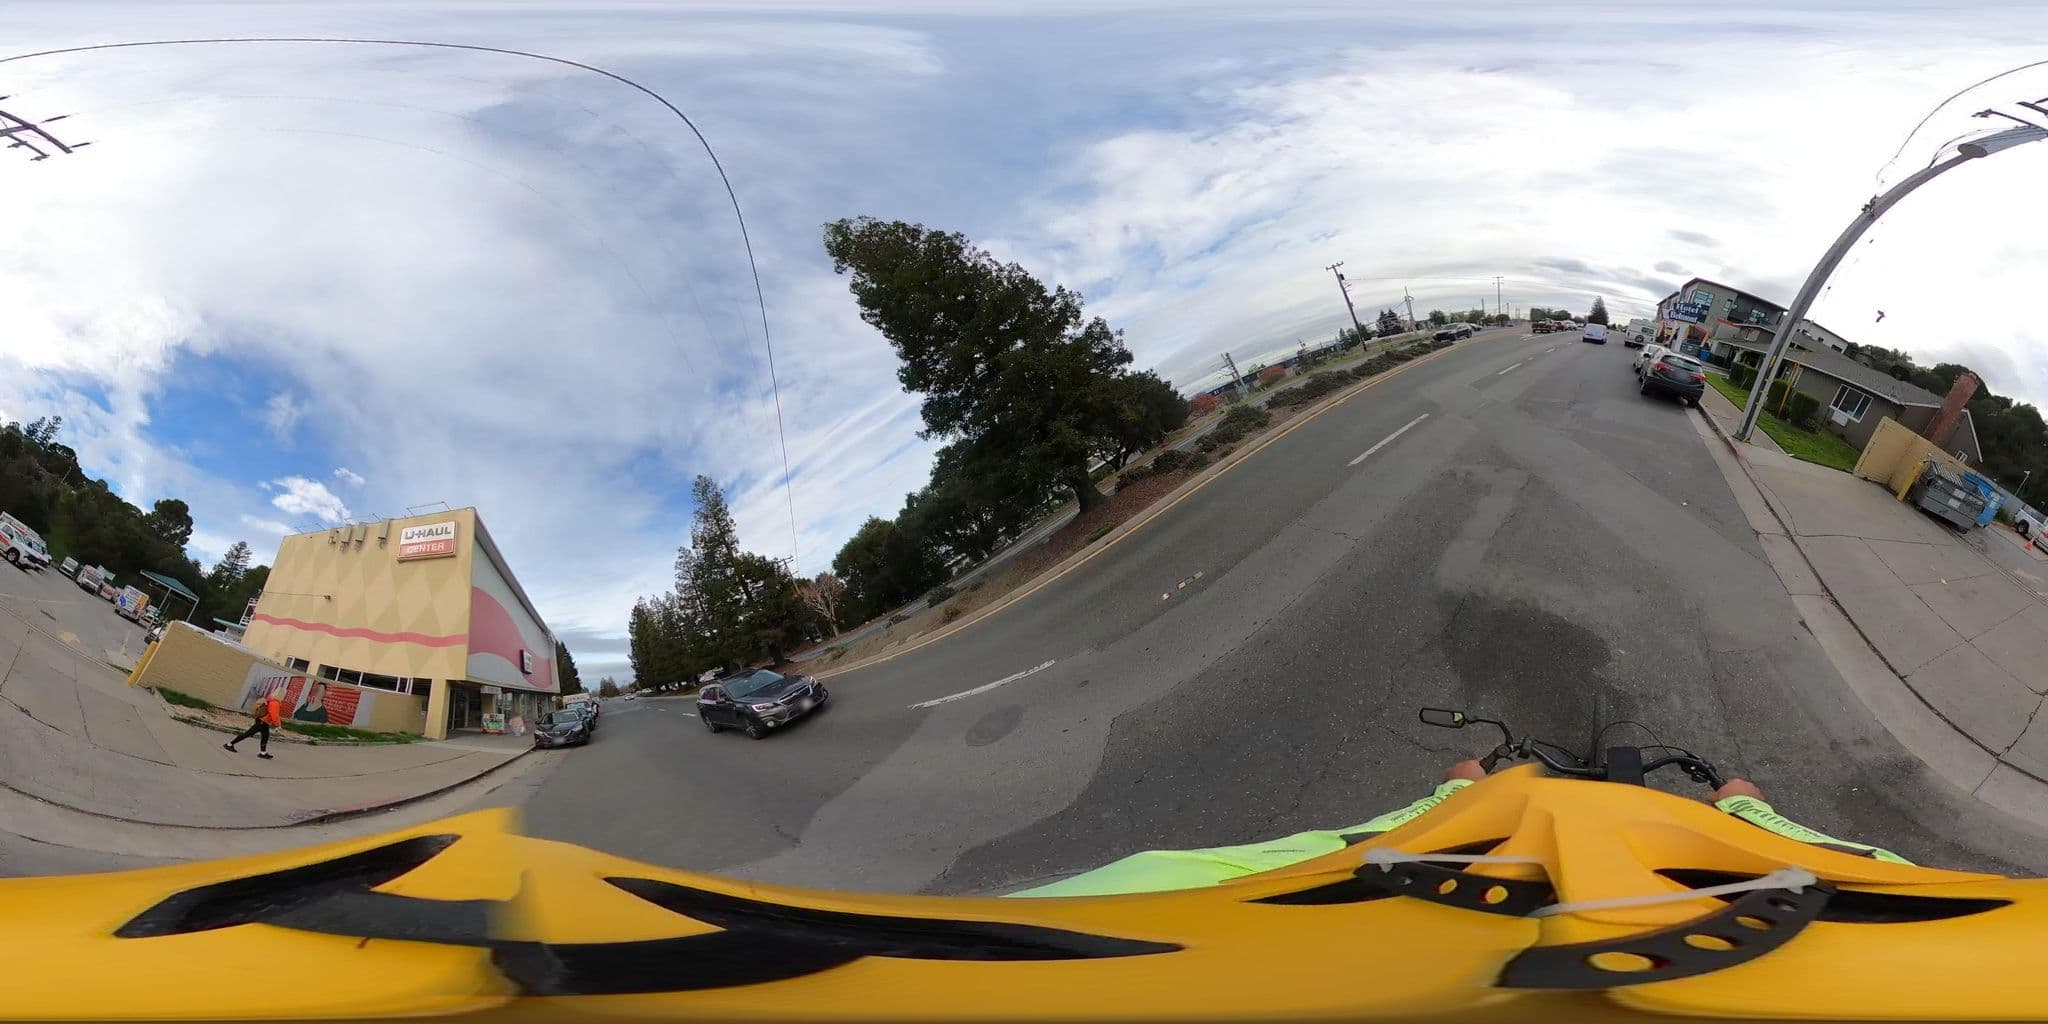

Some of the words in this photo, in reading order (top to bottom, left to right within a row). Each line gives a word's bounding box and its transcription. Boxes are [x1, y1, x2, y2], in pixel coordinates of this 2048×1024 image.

[1676, 303, 1699, 314] Hotel
[405, 526, 451, 539] U-HAUL
[406, 542, 444, 553] CENTER
